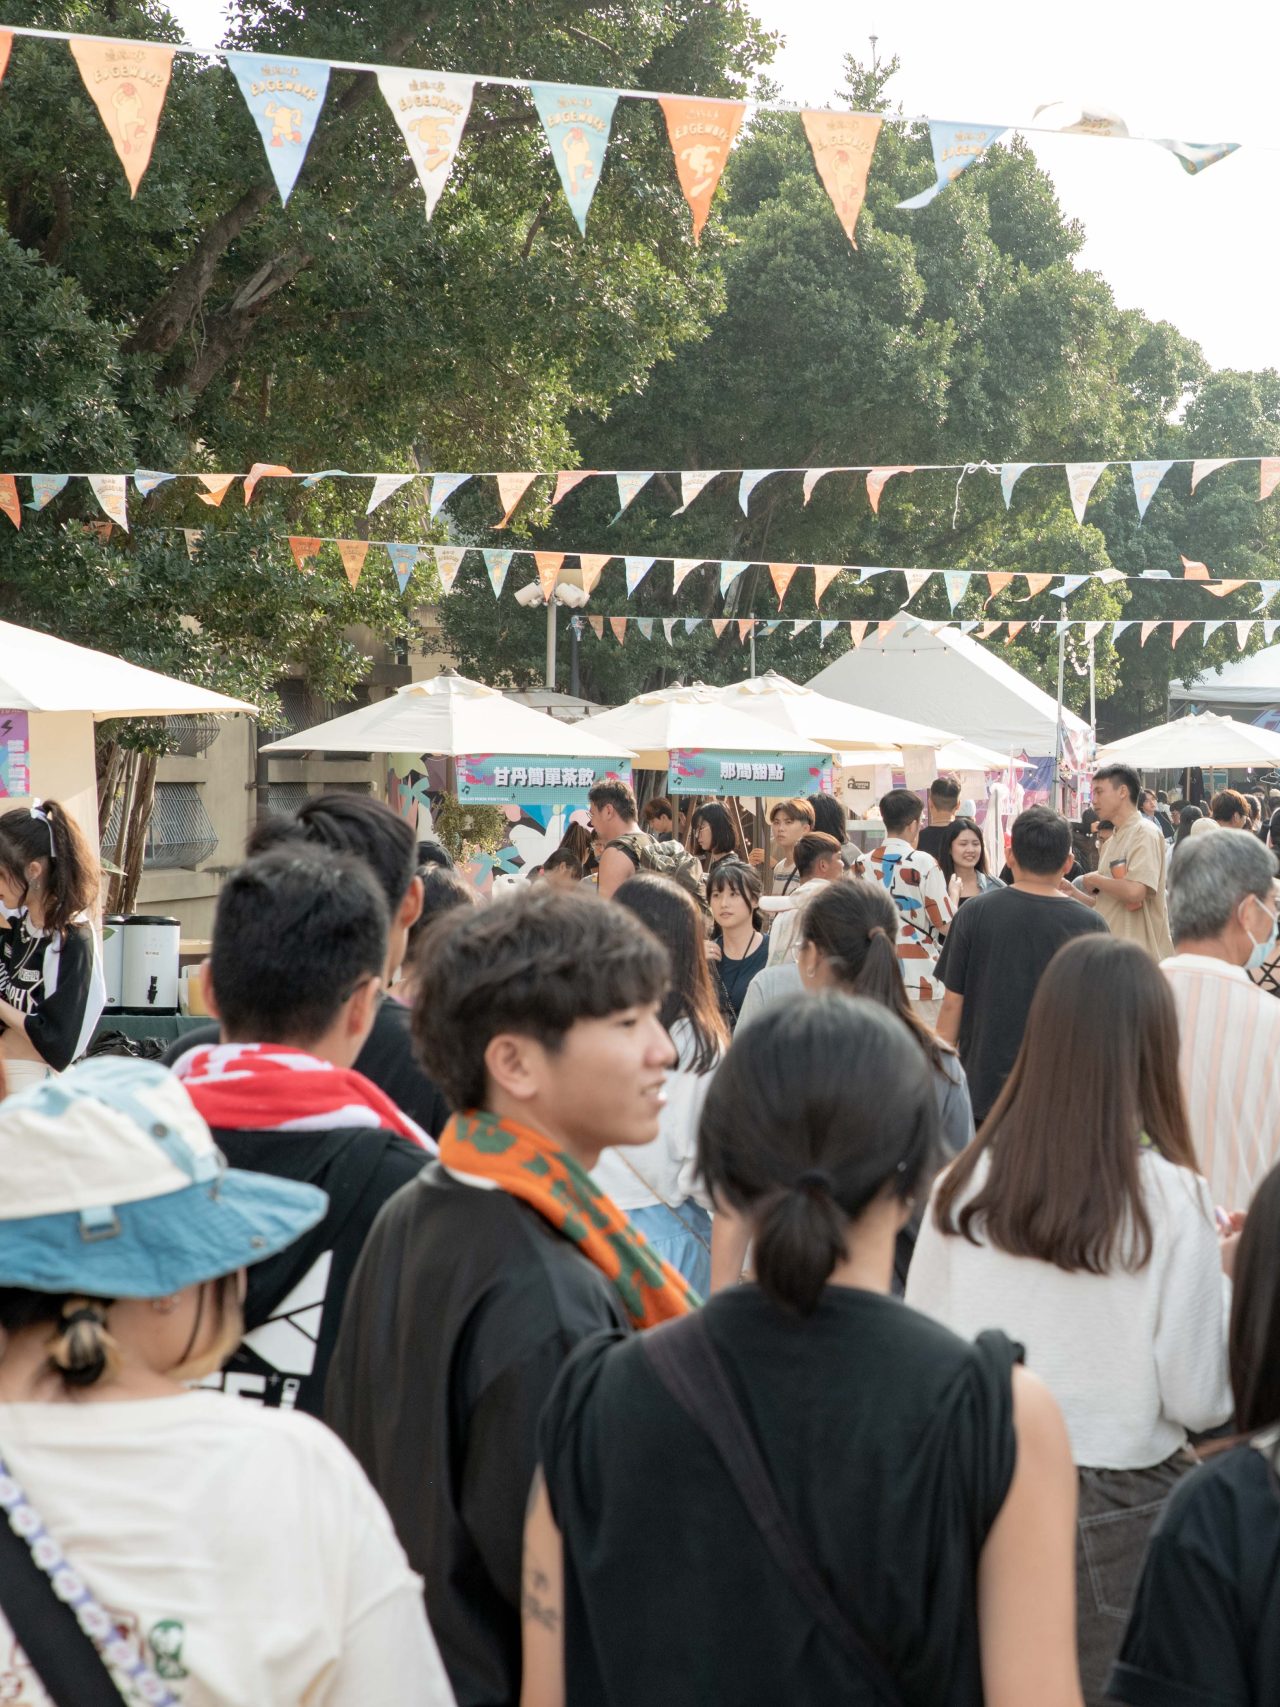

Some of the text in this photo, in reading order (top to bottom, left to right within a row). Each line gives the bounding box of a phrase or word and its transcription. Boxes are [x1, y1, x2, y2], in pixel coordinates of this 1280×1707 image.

[494, 767, 595, 788] 甘丹簡單茶飲
[720, 762, 785, 781] 那間甜點
